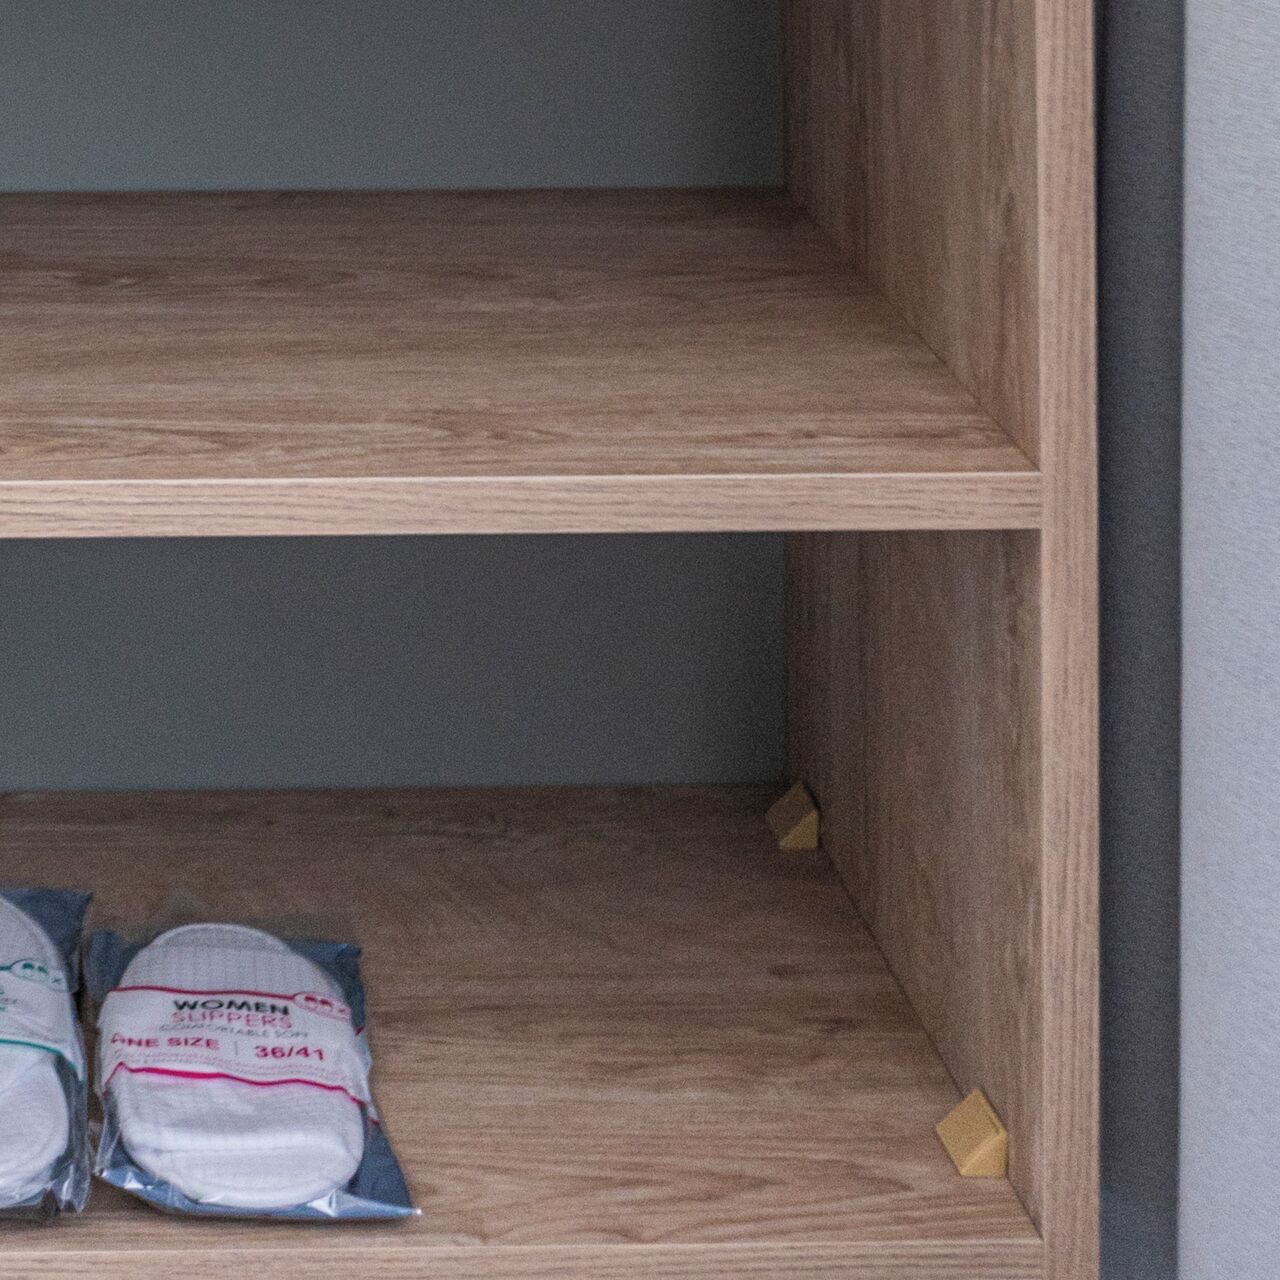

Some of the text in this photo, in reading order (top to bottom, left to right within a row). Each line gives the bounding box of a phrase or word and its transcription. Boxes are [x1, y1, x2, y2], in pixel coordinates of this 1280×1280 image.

[174, 999, 290, 1016] WOMEN
[172, 1012, 293, 1029] SLIPPERS
[167, 1036, 221, 1050] SIZE
[254, 1045, 325, 1062] 36/41
